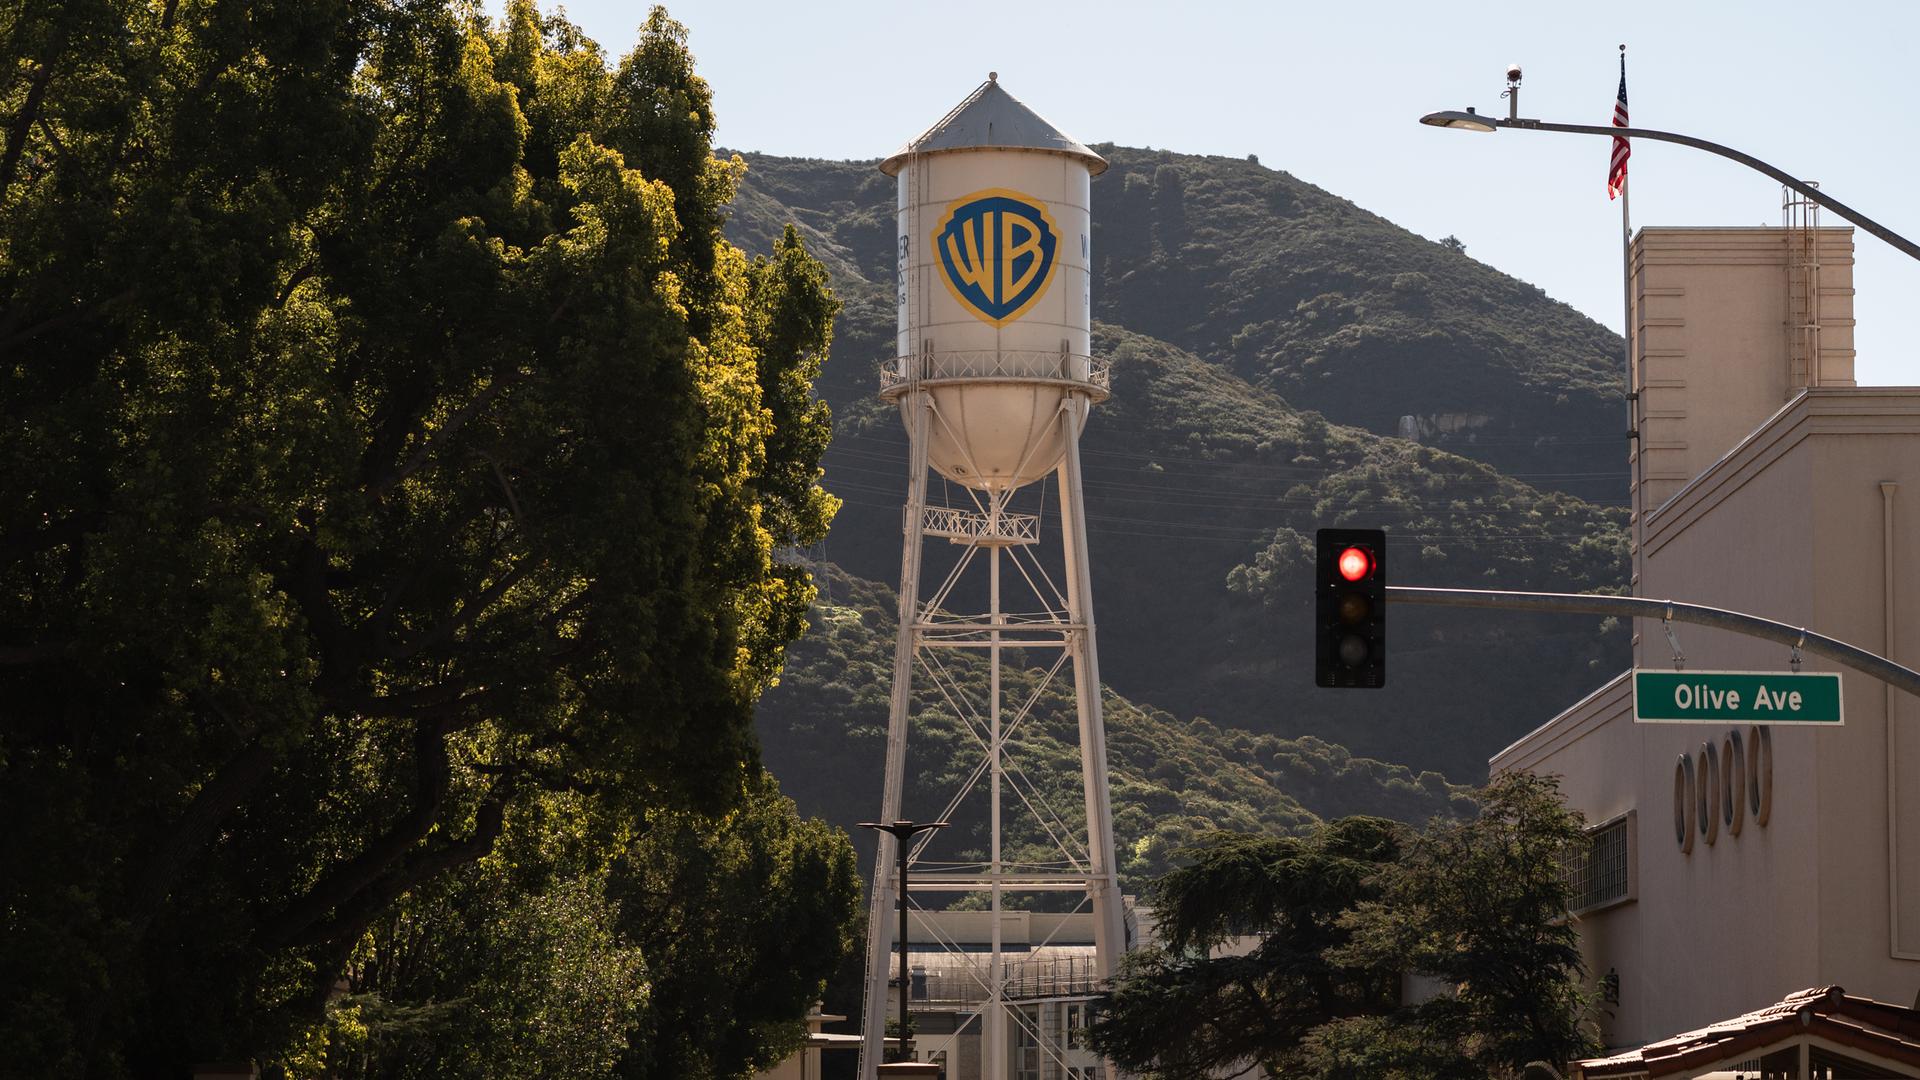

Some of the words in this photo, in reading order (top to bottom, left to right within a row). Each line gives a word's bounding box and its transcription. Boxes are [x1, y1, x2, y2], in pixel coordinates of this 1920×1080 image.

[946, 211, 1044, 305] WB
[1674, 683, 1740, 710] Olive
[1753, 685, 1802, 711] Ave
